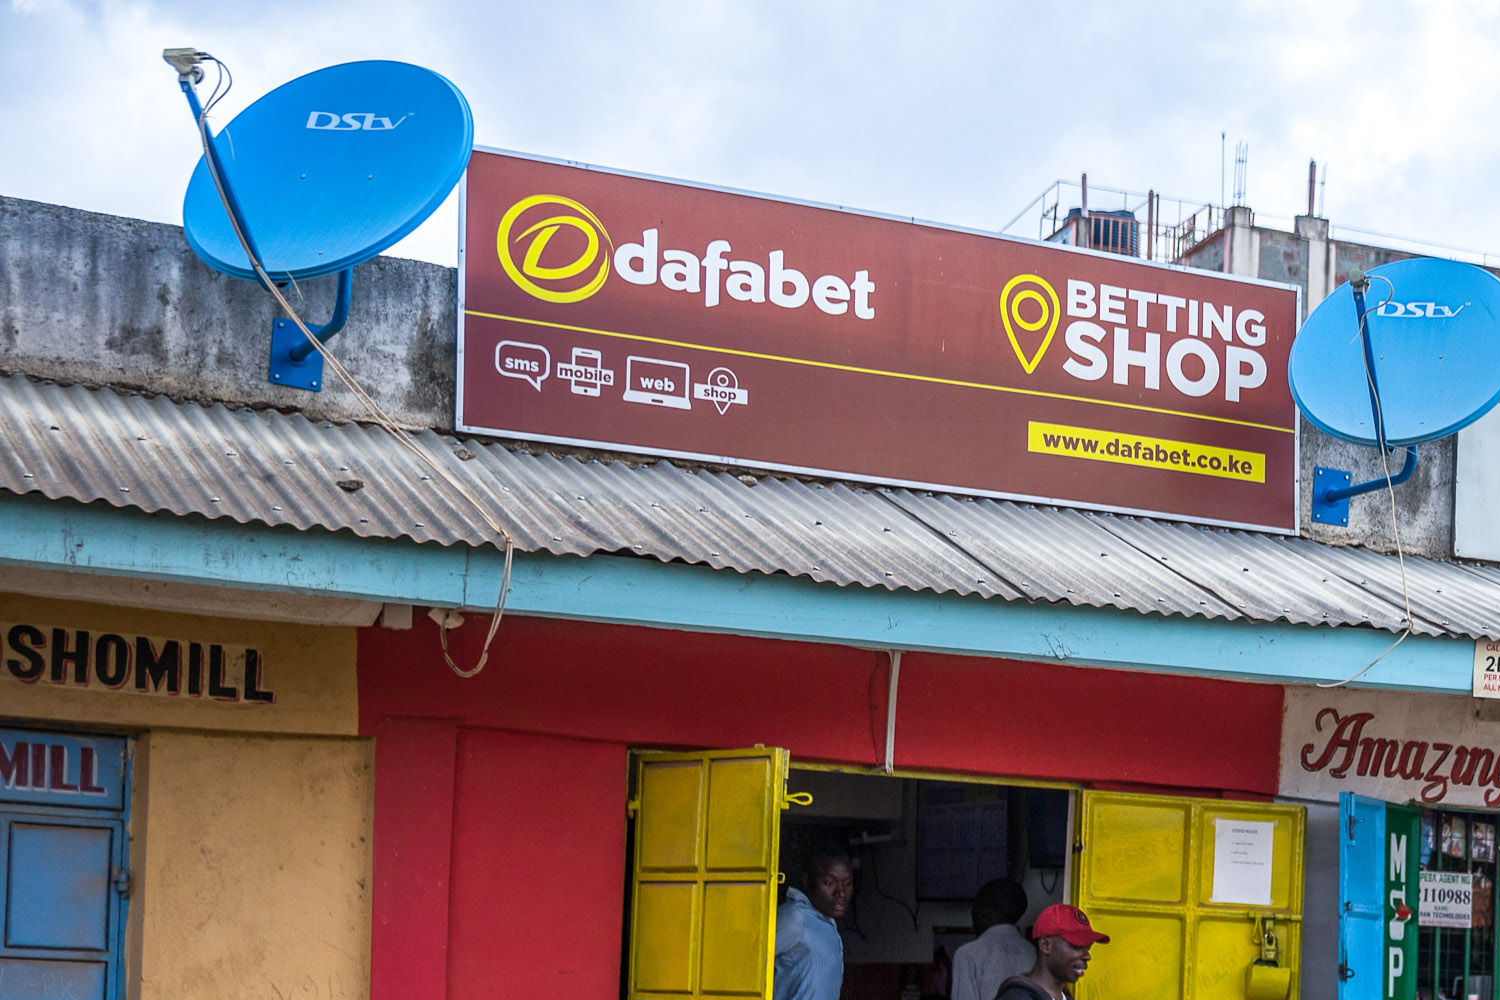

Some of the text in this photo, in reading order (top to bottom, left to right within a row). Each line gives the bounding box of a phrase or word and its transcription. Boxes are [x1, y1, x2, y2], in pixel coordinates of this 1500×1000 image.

[613, 227, 876, 320] dafabet
[1066, 278, 1267, 347] BETTING
[505, 356, 540, 373] sms
[1062, 320, 1268, 403] SHOP
[559, 365, 612, 384] mobile
[640, 375, 675, 393] web
[703, 386, 737, 402] shop
[1042, 432, 1253, 475] www.dafabet.co.ke
[0, 624, 276, 703] SHOMILL
[1483, 674, 1497, 682] PER
[1483, 684, 1497, 692] ALL
[1420, 888, 1471, 905] 110988
